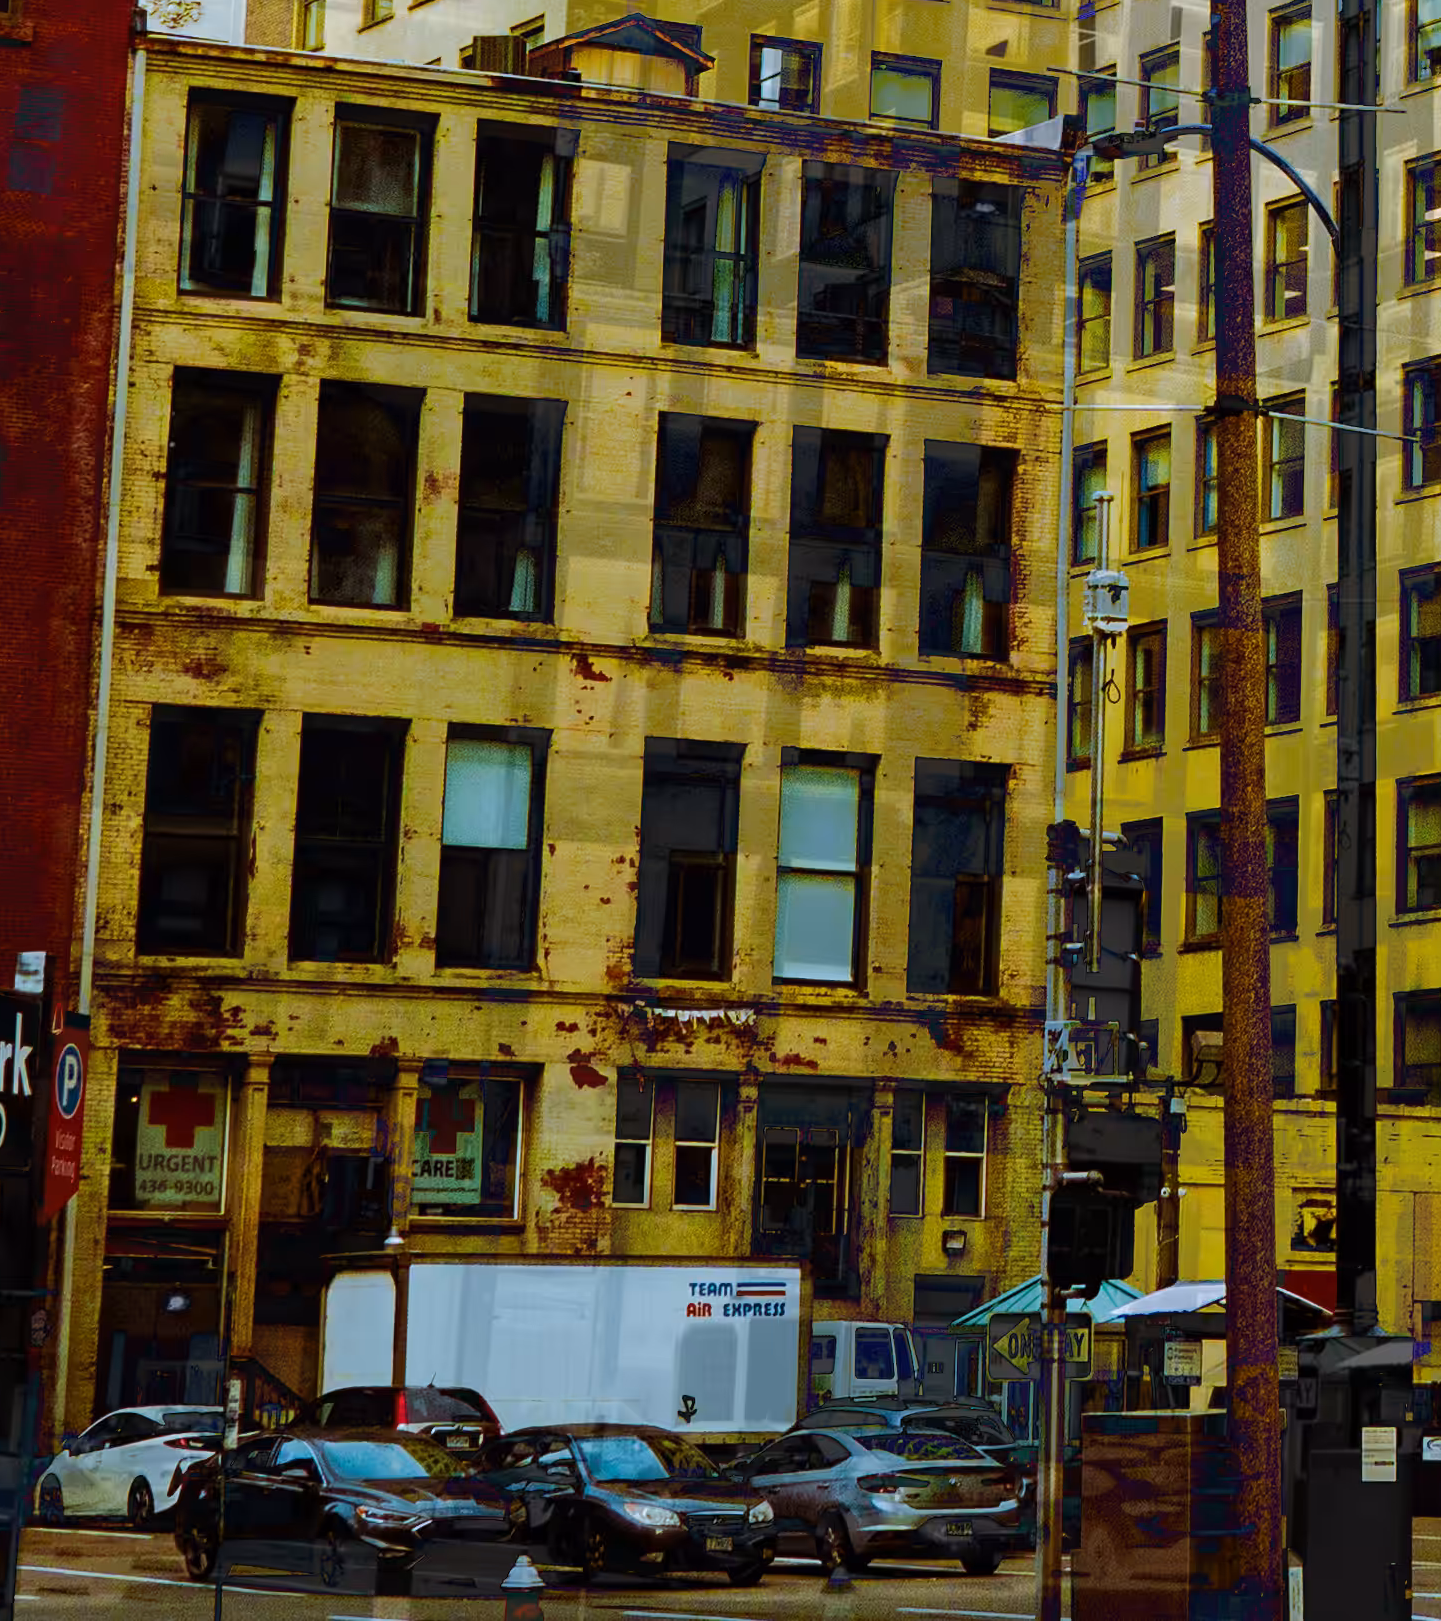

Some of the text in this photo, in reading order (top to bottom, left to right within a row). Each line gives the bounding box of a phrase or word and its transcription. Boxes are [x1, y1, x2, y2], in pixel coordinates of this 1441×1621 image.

[62, 1055, 78, 1108] P
[50, 1155, 76, 1184] Parking
[139, 1153, 217, 1173] URGENT
[411, 1159, 454, 1178] CARE
[138, 1179, 214, 1196] 436-9300
[689, 1282, 733, 1297] TEAM
[723, 1302, 786, 1317] EXPRESS
